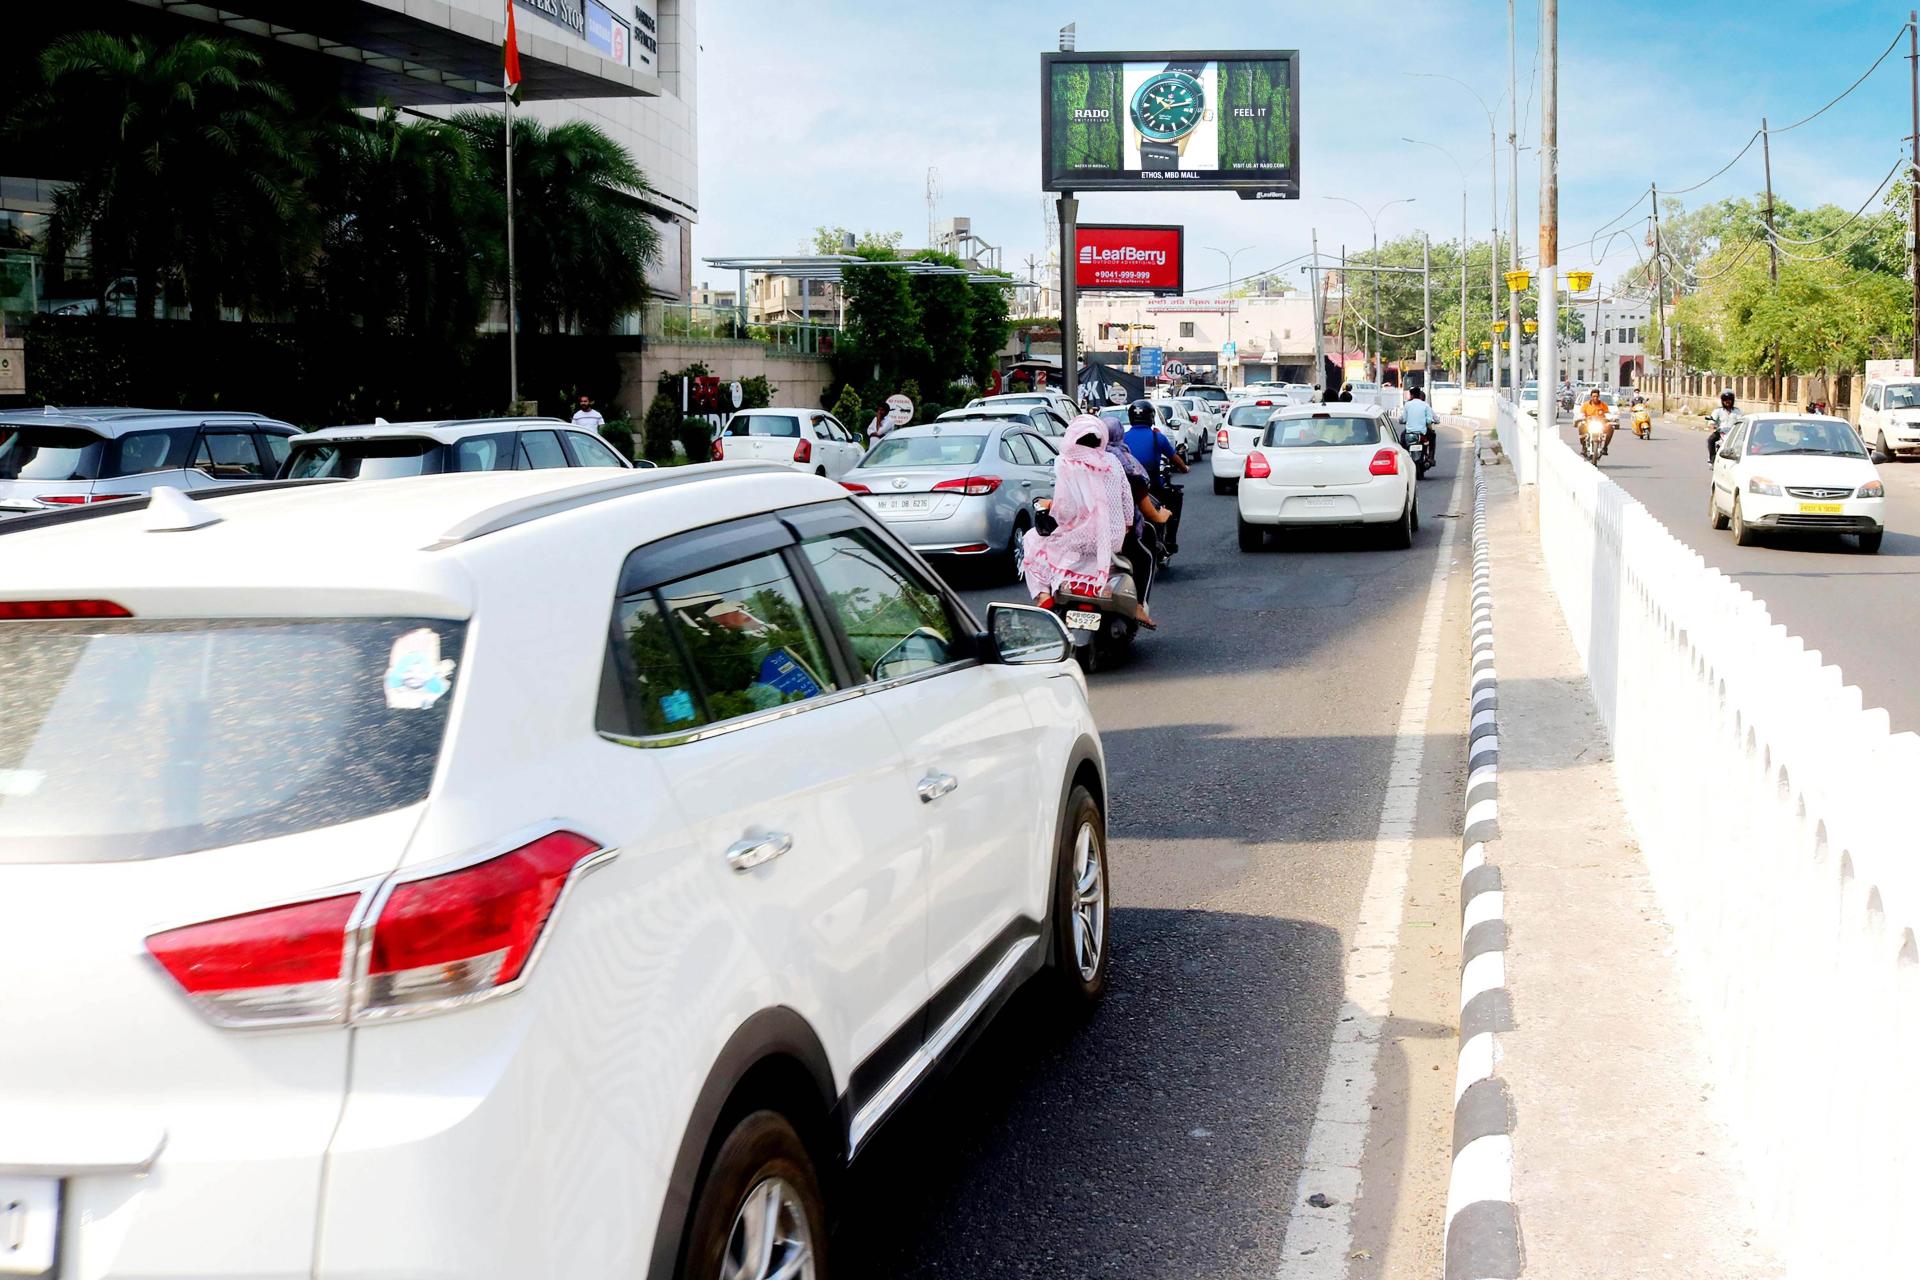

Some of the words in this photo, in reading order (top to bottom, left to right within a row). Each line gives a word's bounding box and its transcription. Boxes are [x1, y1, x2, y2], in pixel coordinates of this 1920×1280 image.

[561, 0, 584, 33] STOP
[1074, 109, 1110, 118] RADO
[1234, 108, 1255, 117] FEEL
[1257, 108, 1267, 117] IT
[1141, 171, 1164, 179] ETHOS,
[1164, 171, 1180, 179] MBD
[1092, 246, 1166, 265] LeafBerry
[1166, 363, 1182, 375] 40
